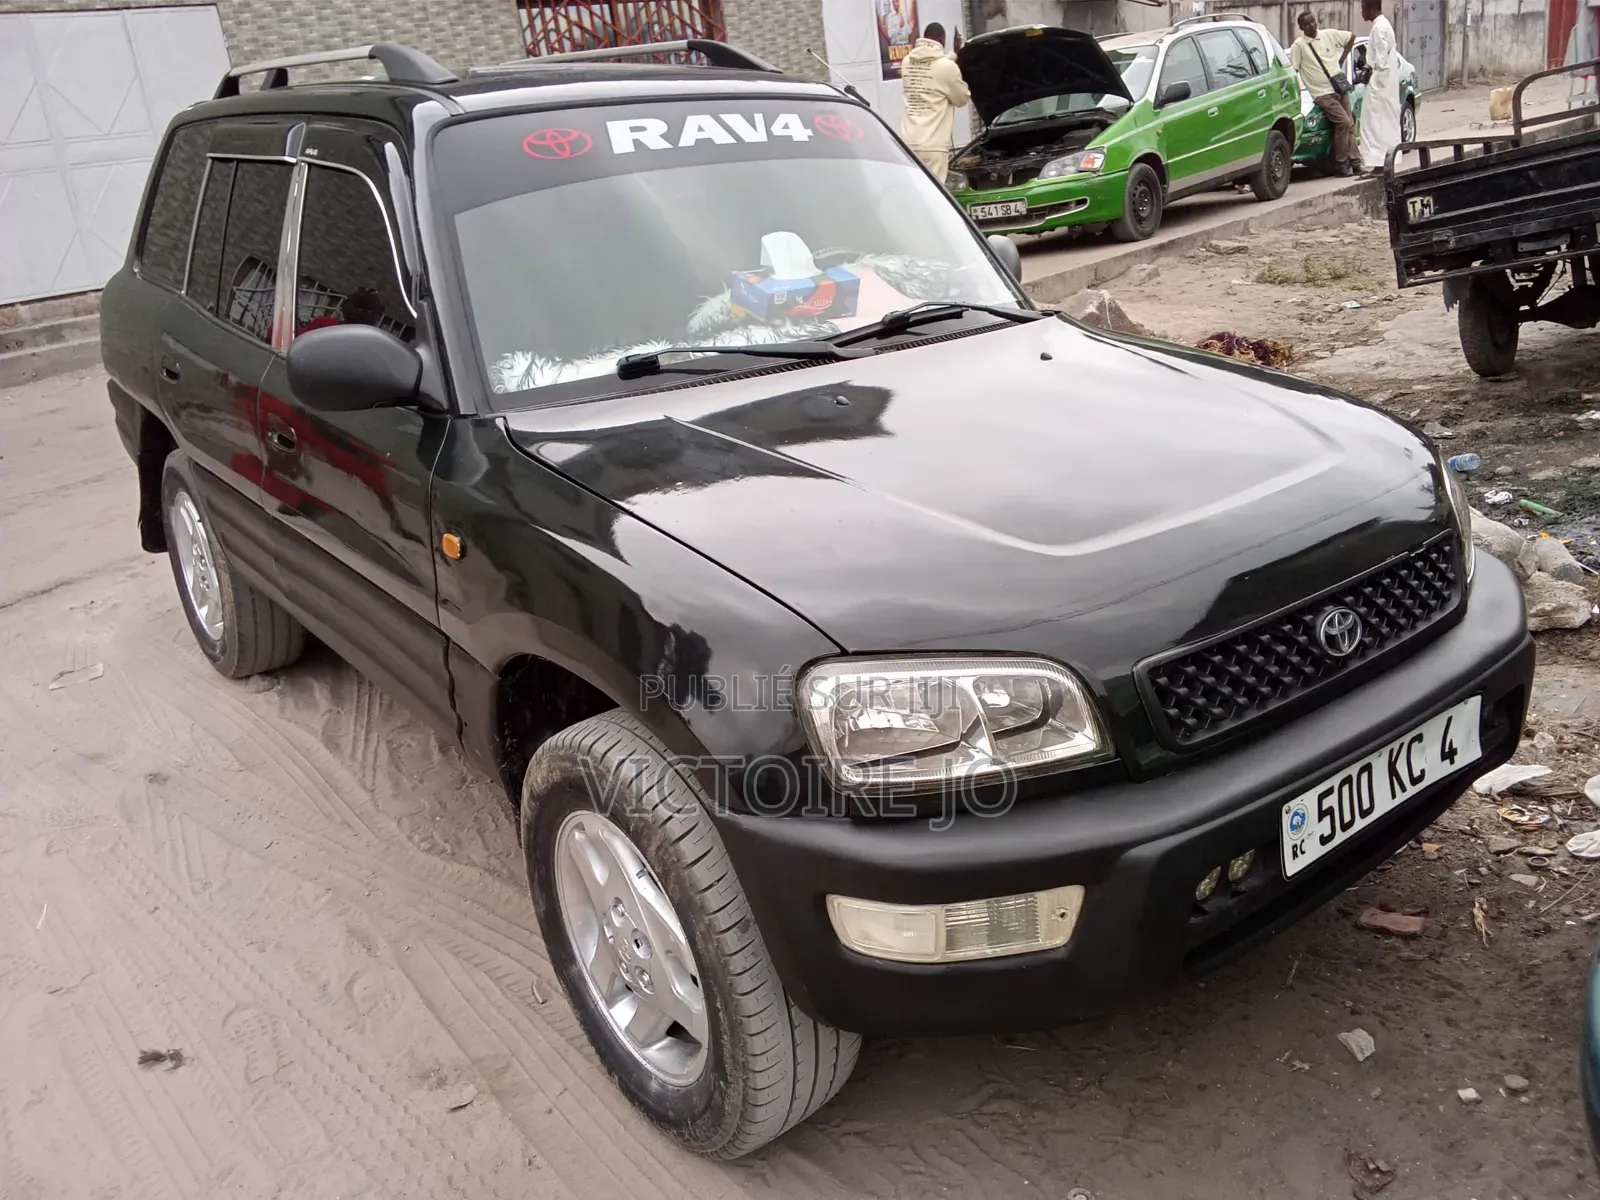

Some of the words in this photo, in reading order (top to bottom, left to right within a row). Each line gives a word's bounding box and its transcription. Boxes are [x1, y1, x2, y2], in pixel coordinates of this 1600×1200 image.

[605, 112, 813, 154] RAV4
[980, 206, 998, 217] 541
[1001, 205, 1012, 215] SB
[1015, 204, 1020, 214] 4
[1317, 762, 1375, 846] 500
[1388, 732, 1426, 800] KC
[1440, 715, 1458, 765] 4
[1291, 838, 1306, 860] RC
